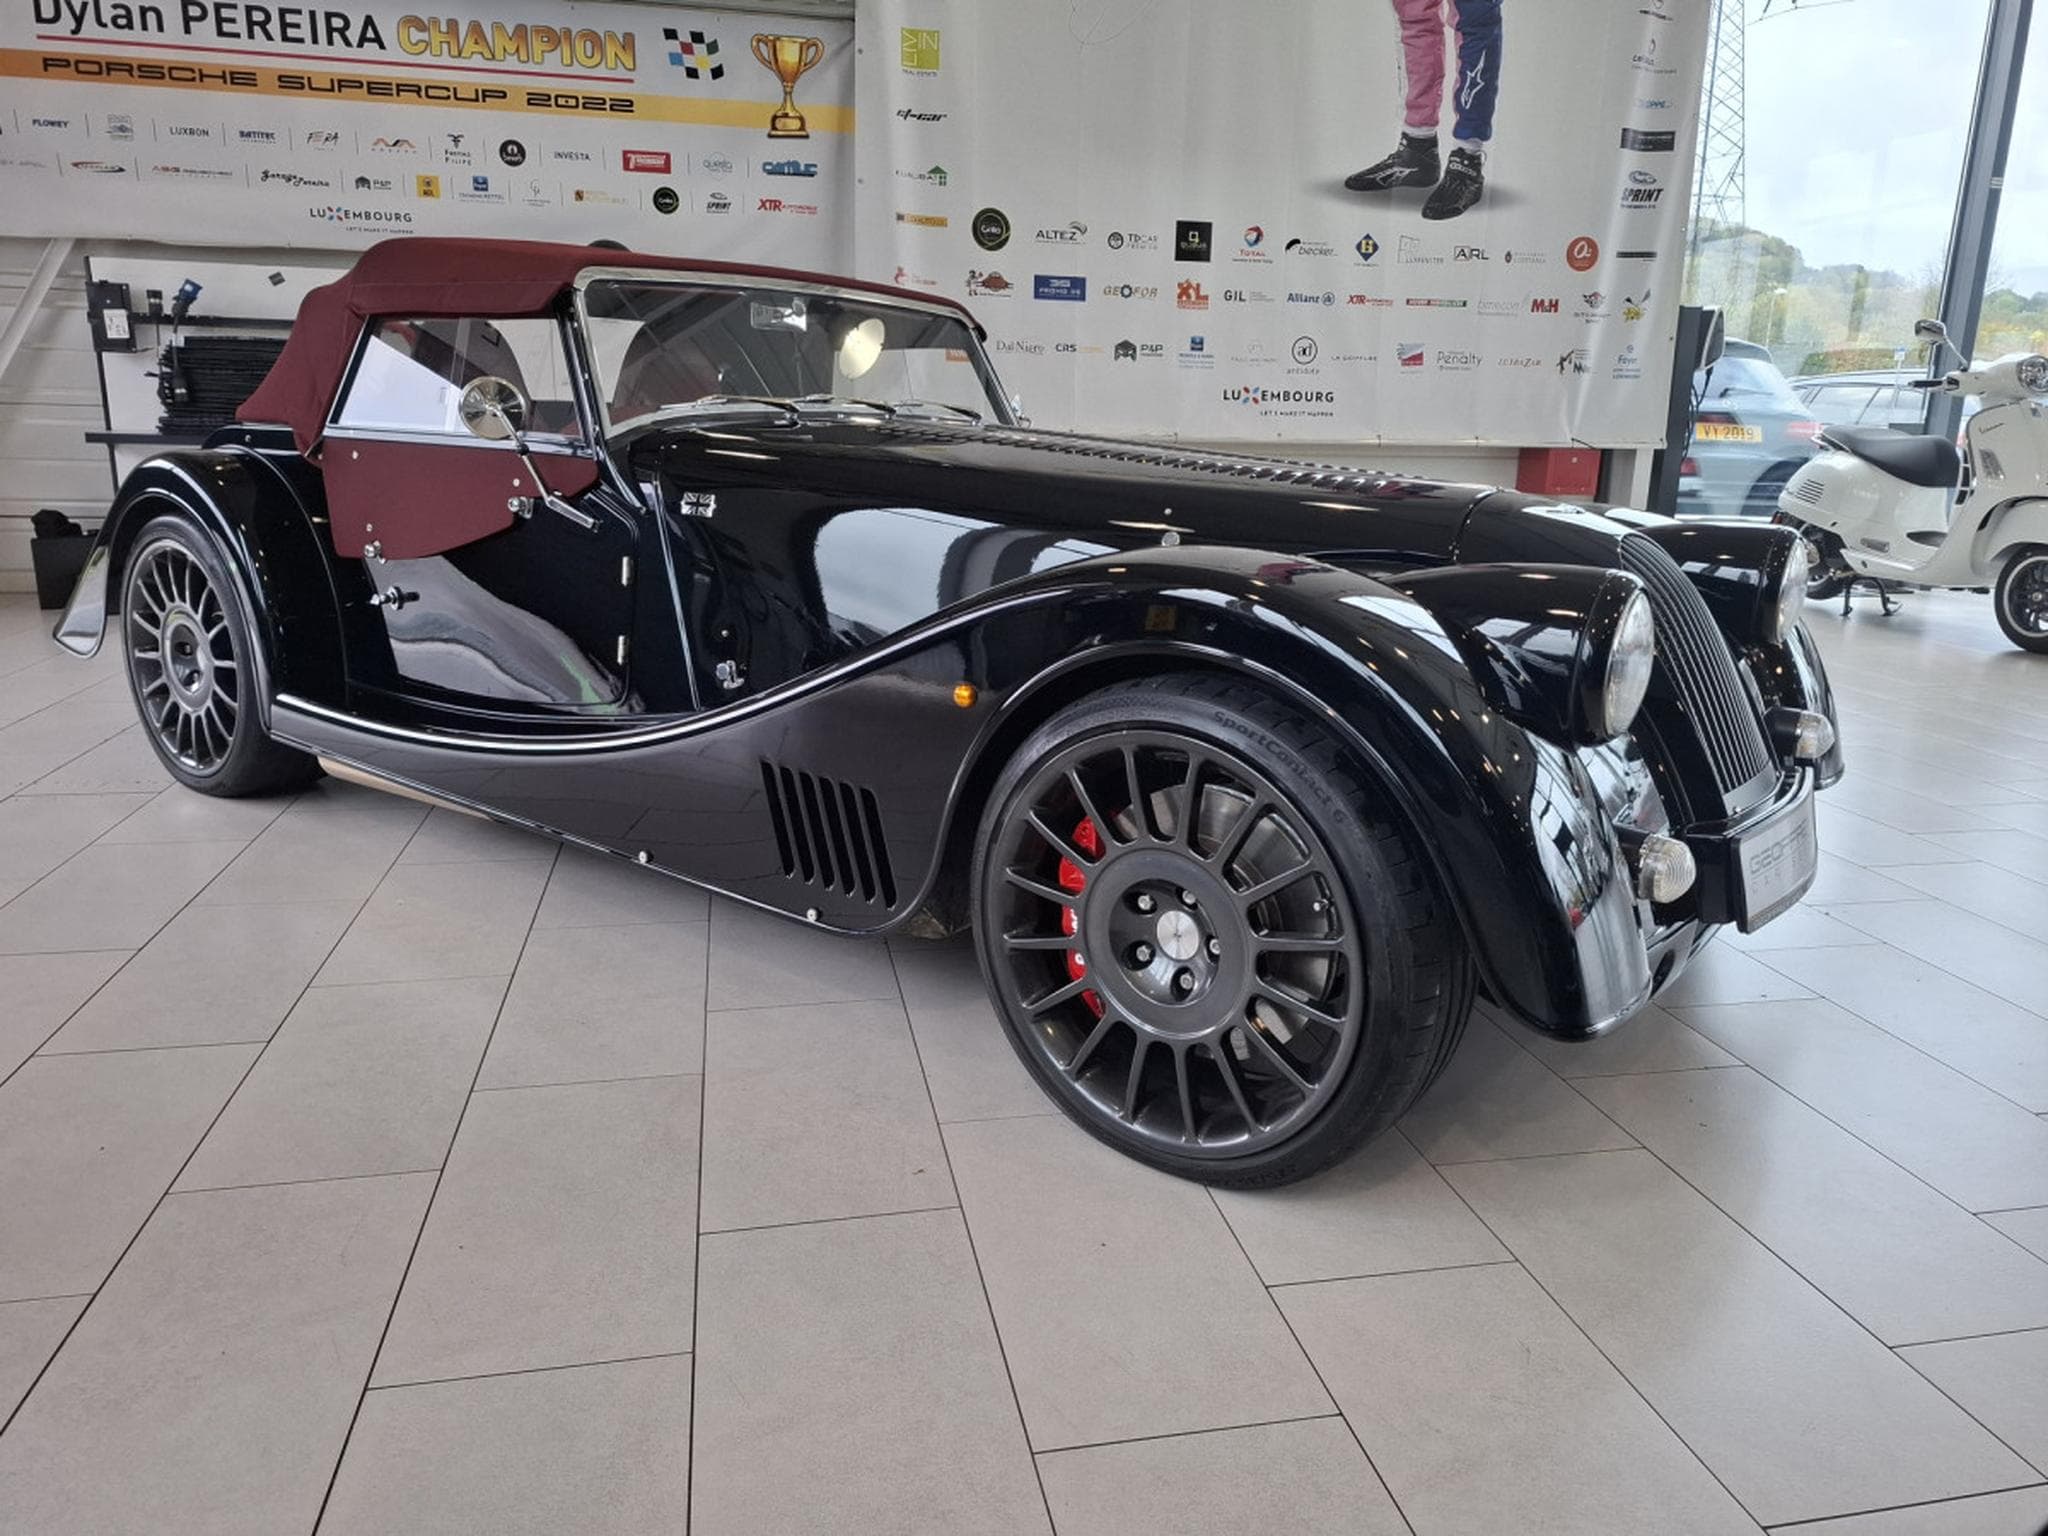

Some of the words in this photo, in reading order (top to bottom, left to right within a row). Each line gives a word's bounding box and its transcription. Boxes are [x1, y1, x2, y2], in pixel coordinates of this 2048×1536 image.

[34, 0, 165, 35] Dylan
[182, 0, 387, 51] PEREIRA
[397, 14, 636, 72] CHAMPION
[42, 57, 258, 88] PORSCHE
[277, 75, 508, 104] SUPERCUP
[527, 91, 635, 114] 2022
[553, 151, 591, 161] INVESTA
[1622, 188, 1664, 203] SPRINT
[757, 198, 783, 212] XTR
[310, 206, 412, 223] LUXEMBOURG
[1035, 229, 1078, 241] ALTEZ
[1239, 249, 1266, 257] TOTAL
[1455, 246, 1489, 261] ARL
[1103, 283, 1158, 299] GEOFOR
[1224, 290, 1246, 302] GIL
[1287, 292, 1320, 304] Allianz
[1347, 295, 1366, 305] XTR
[1055, 343, 1078, 353] CRS
[1436, 350, 1483, 368] Penalty
[1223, 386, 1335, 405] LUXEMBOURG
